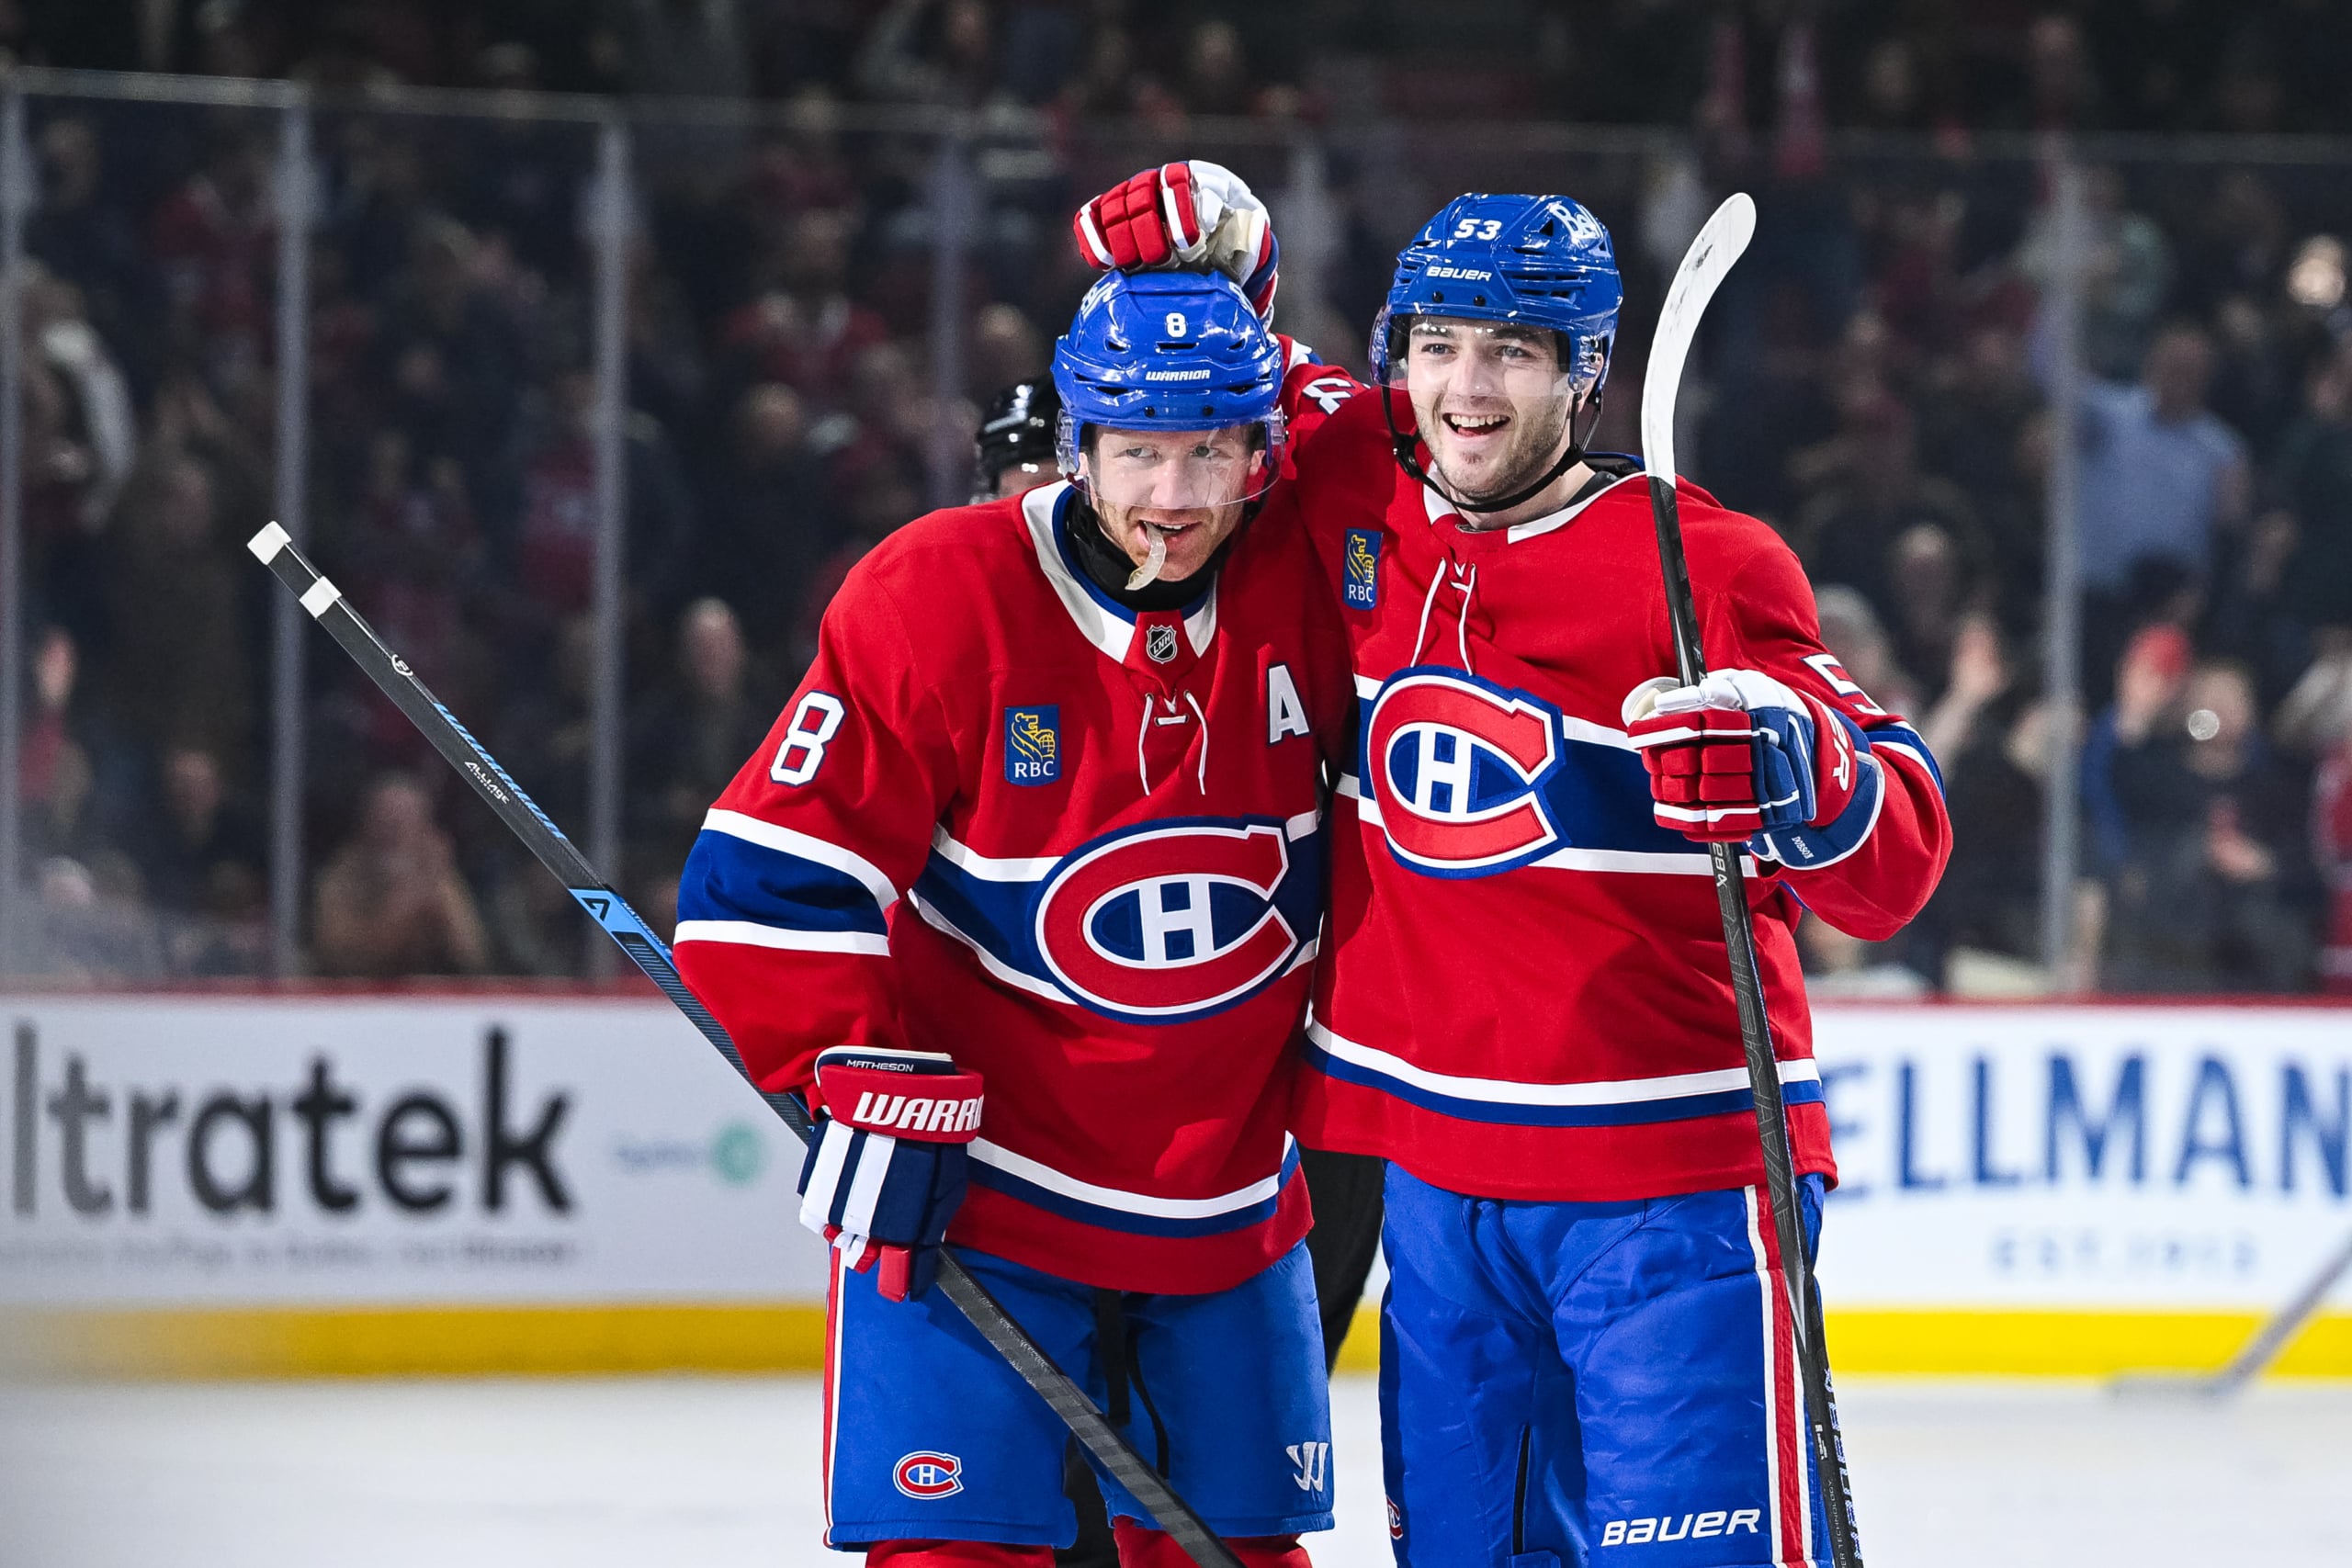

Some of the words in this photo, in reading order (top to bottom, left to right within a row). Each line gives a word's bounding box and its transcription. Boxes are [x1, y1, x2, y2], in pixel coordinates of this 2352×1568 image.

[1453, 219, 1502, 241] 53
[1165, 312, 1187, 338] 8
[1146, 369, 1211, 382] WARRIOR
[1348, 584, 1373, 603] RBC
[1153, 633, 1170, 655] LNH
[1267, 664, 1310, 745] A
[769, 691, 847, 786] 8
[1014, 761, 1055, 779] RBC
[1791, 836, 1815, 859] DOBSON
[846, 1059, 914, 1073] MATHESON
[1826, 1479, 1845, 1549] TECHNOLOGY
